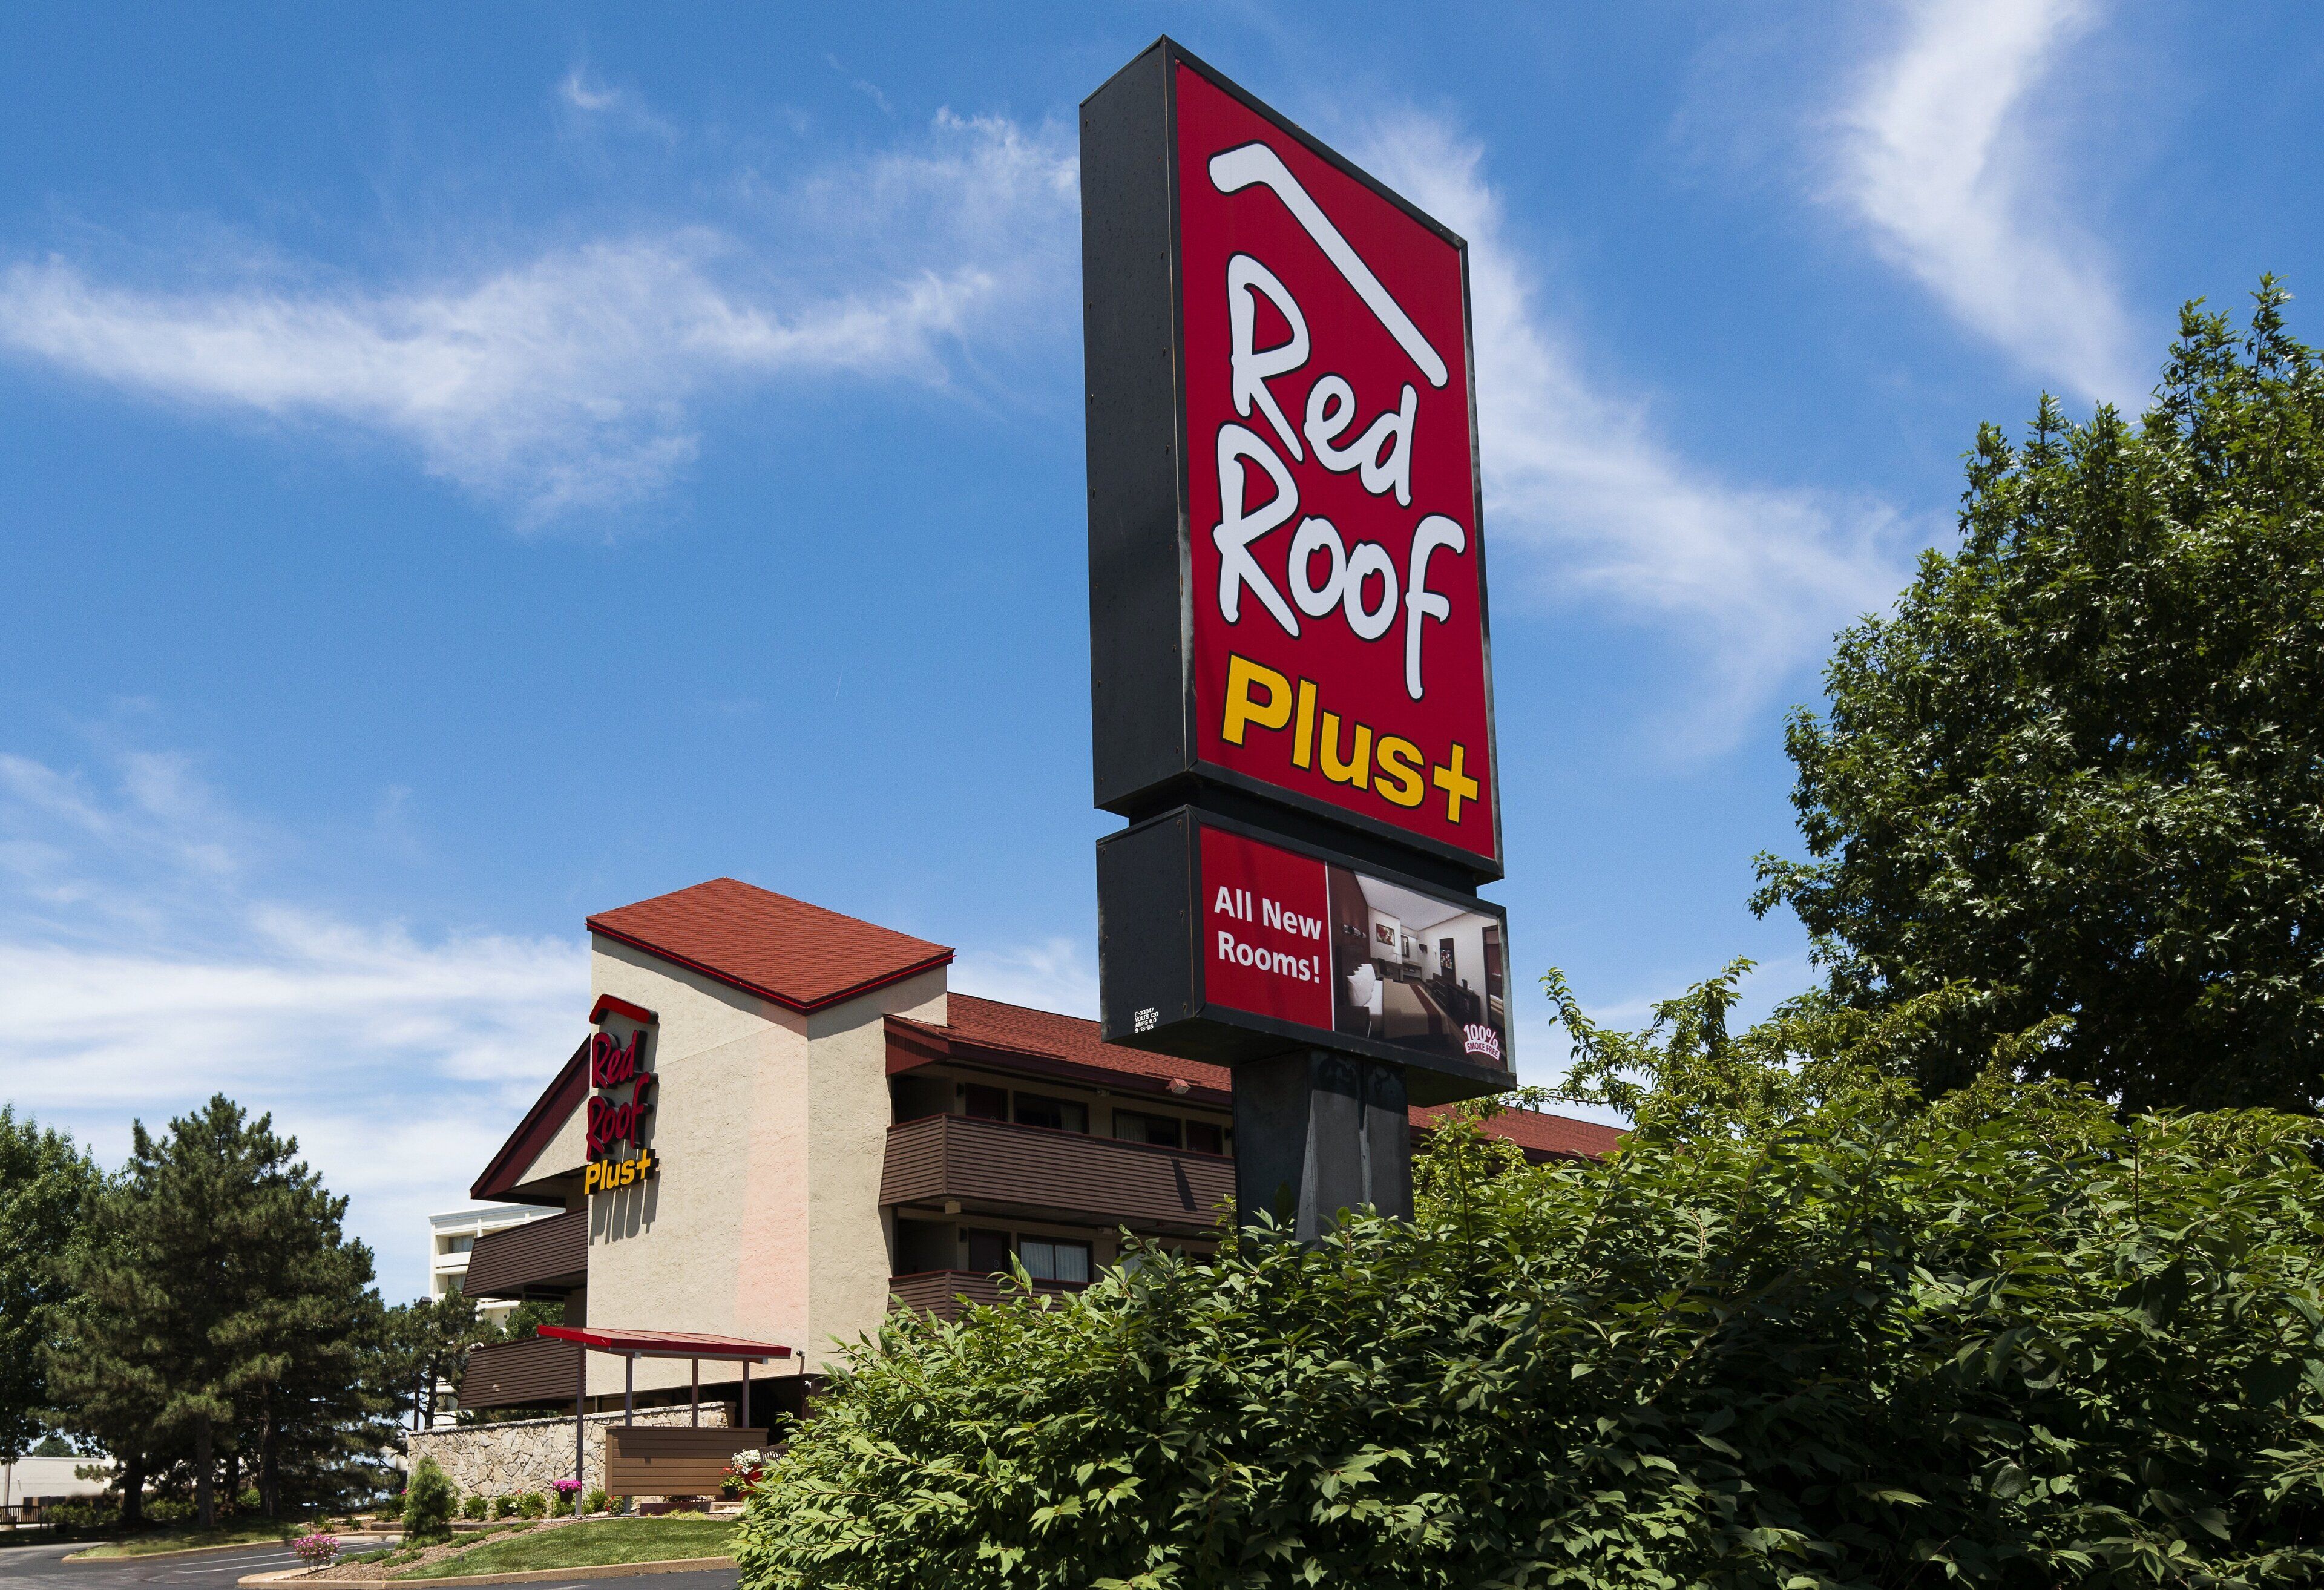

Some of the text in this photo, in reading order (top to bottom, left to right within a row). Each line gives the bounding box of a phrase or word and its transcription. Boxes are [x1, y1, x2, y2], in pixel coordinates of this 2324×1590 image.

[1226, 251, 1419, 508] Red
[1212, 421, 1467, 701] Roof
[1220, 652, 1480, 825] Plus+
[1214, 885, 1322, 940] All New
[1218, 930, 1320, 984] Rooms!
[1135, 1019, 1149, 1028] AMPS
[1463, 1024, 1498, 1048] 100%
[1486, 1045, 1498, 1057] FREE
[592, 1030, 639, 1088] Red
[586, 1071, 651, 1162] Roof
[584, 1148, 651, 1195] Plus+
